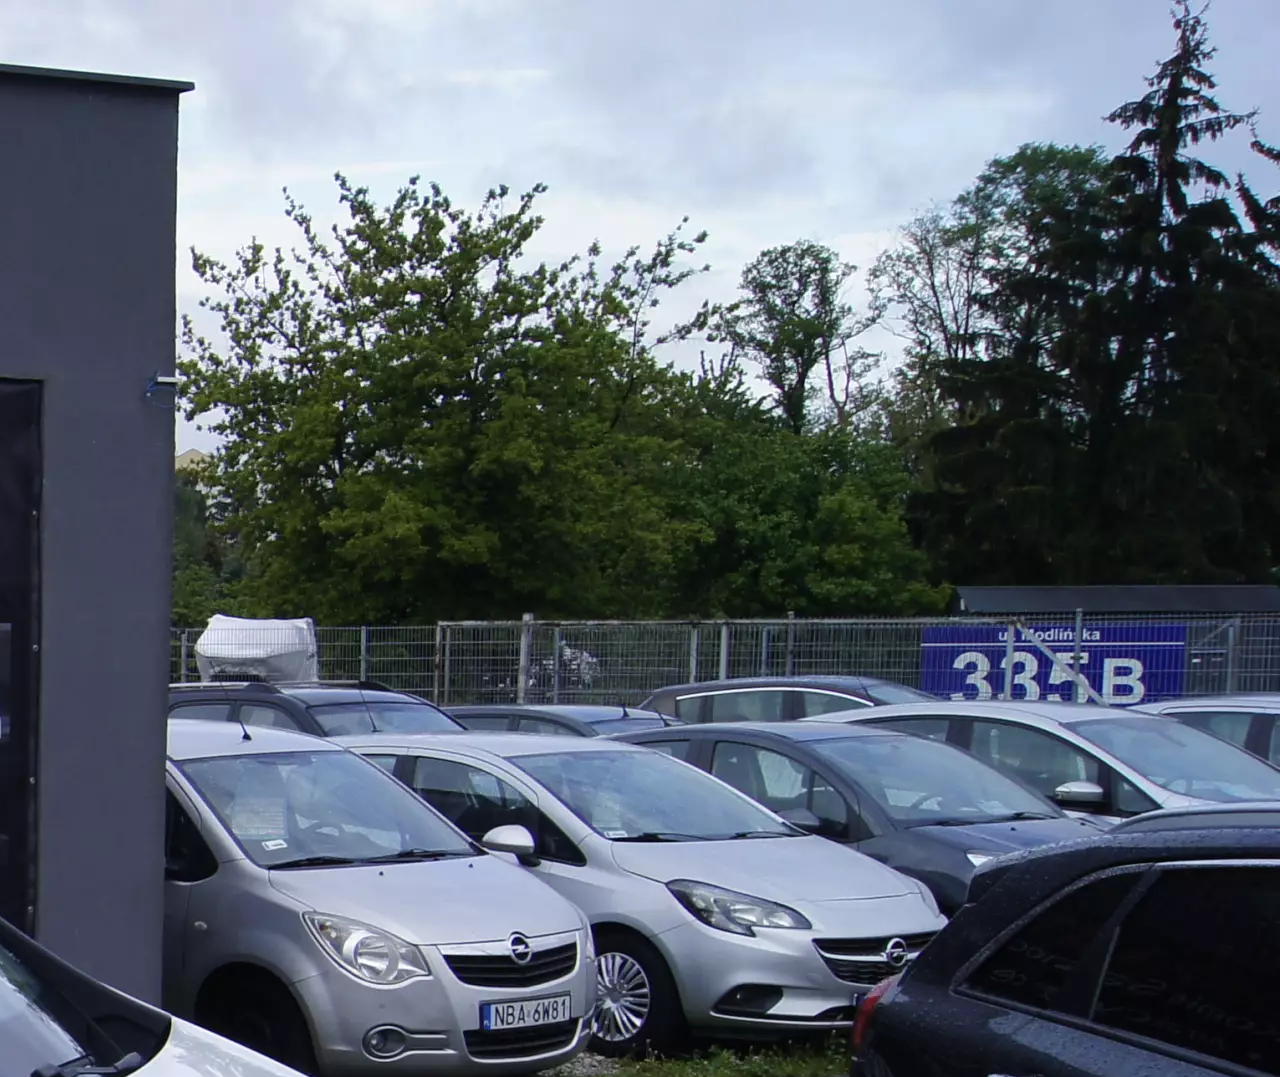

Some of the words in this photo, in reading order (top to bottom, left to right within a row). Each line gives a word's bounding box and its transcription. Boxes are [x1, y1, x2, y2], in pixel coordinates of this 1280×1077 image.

[1022, 628, 1100, 641] odlińka
[495, 1004, 526, 1027] NBA
[533, 998, 567, 1022] 6W81
